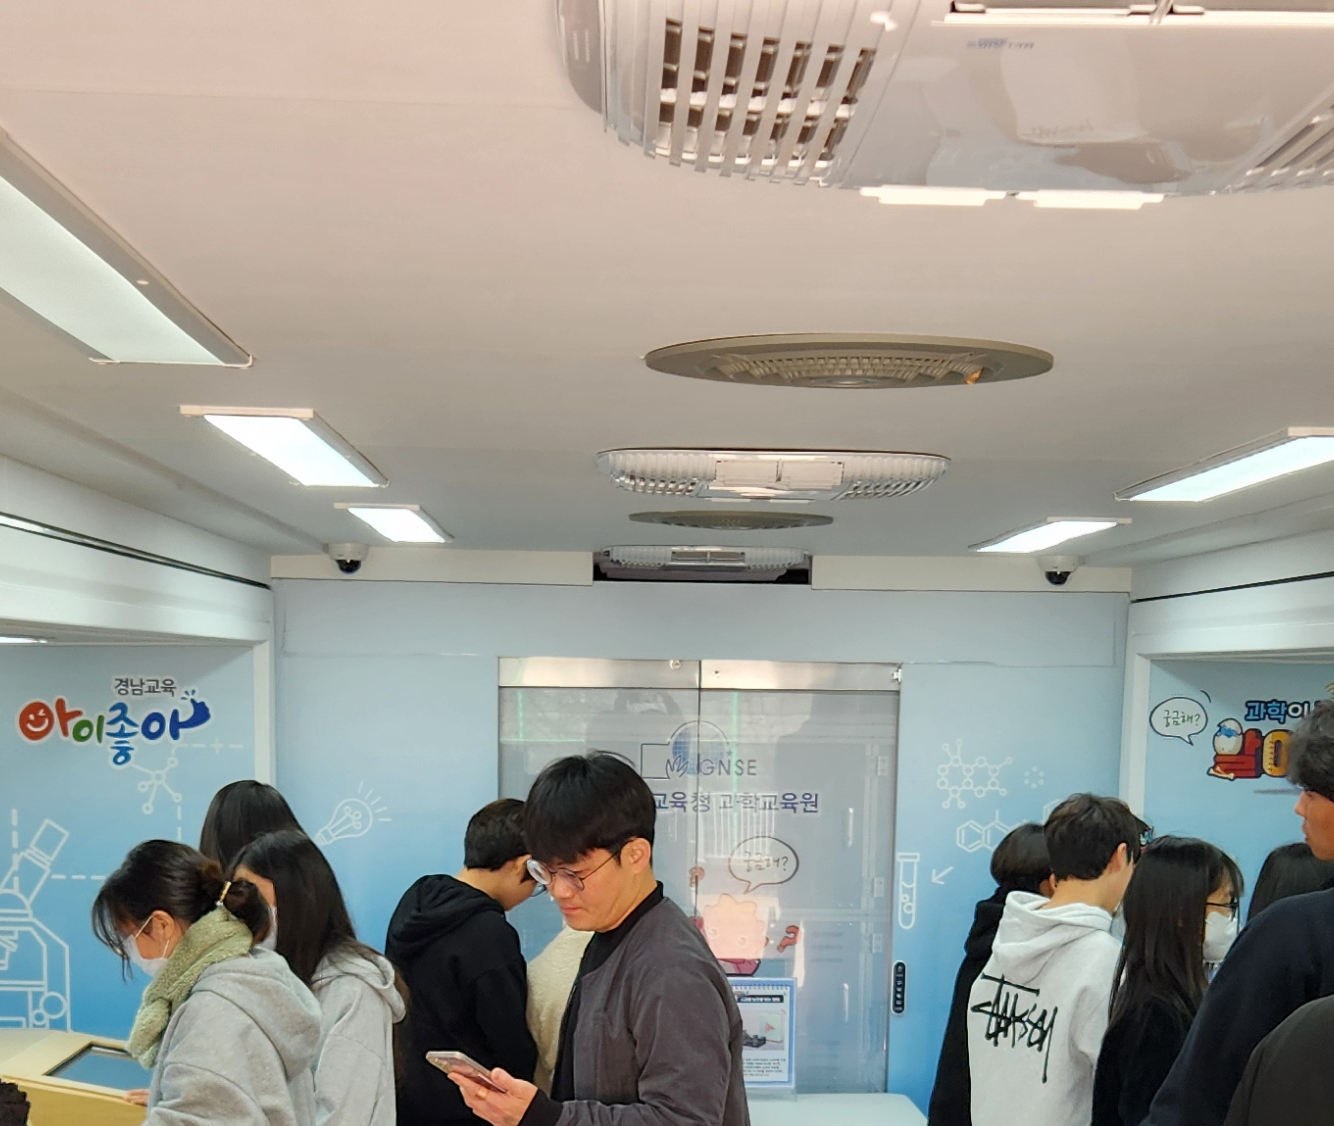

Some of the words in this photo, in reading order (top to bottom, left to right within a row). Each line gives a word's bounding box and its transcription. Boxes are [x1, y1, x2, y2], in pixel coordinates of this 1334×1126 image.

[114, 677, 177, 698] 경남교육
[1163, 709, 1201, 728] 궁금해?
[18, 697, 212, 766] 아이좋아
[719, 791, 819, 814] 과학교육원
